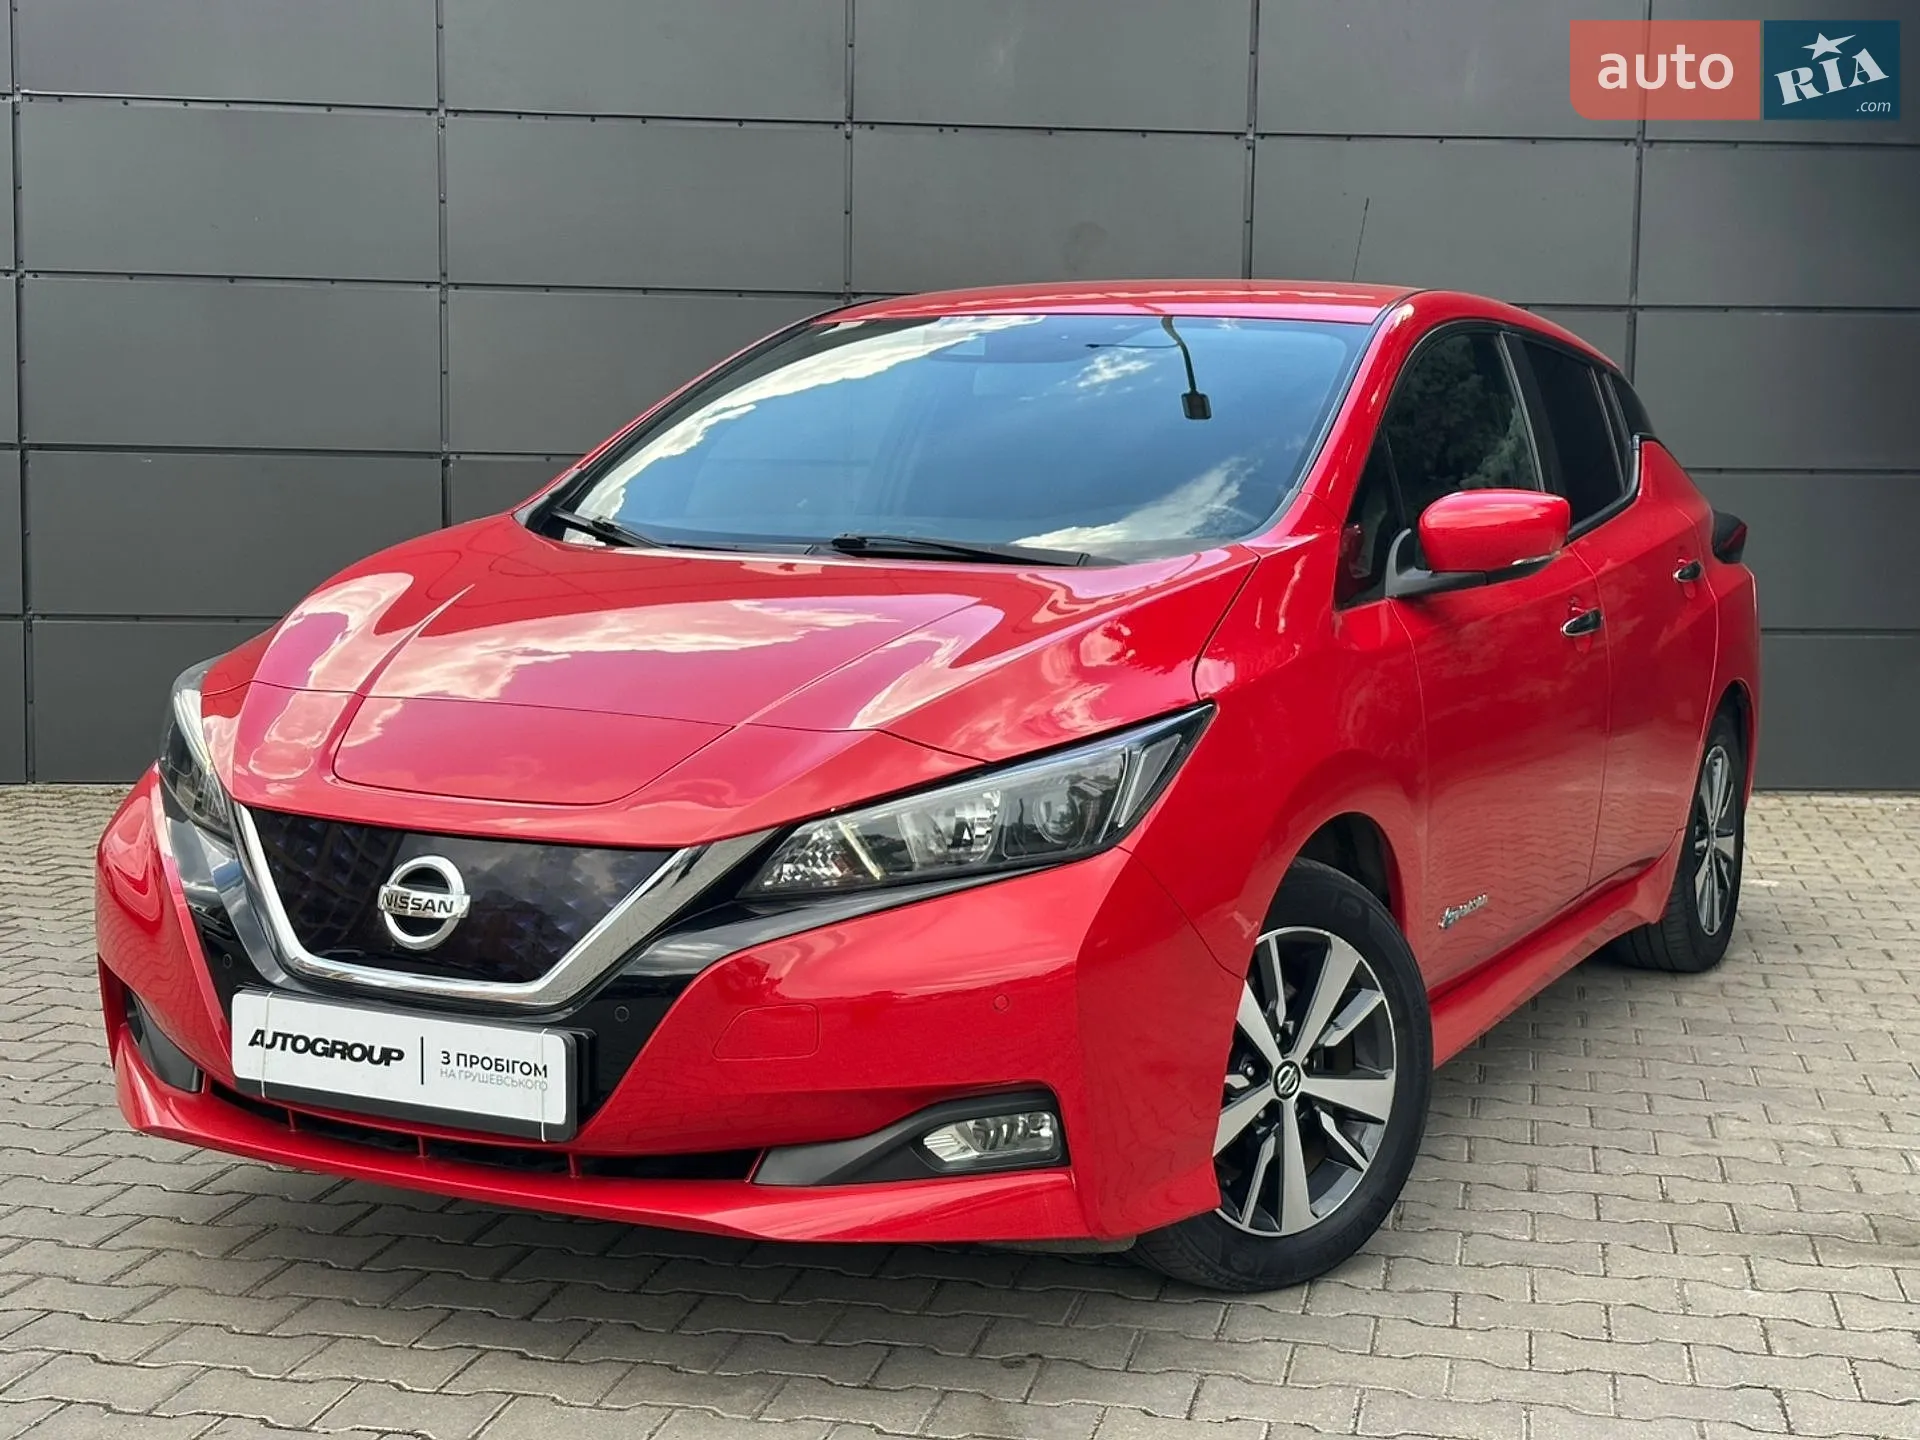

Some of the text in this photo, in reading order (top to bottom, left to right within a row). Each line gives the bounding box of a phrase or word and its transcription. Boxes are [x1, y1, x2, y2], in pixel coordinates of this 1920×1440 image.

[381, 893, 454, 913] NISSAN
[248, 1028, 405, 1067] AUTOGROUP
[456, 1052, 548, 1079] ПРОБІГОМ
[440, 1068, 548, 1092] НА ГРУШЕВСЬКОГО
